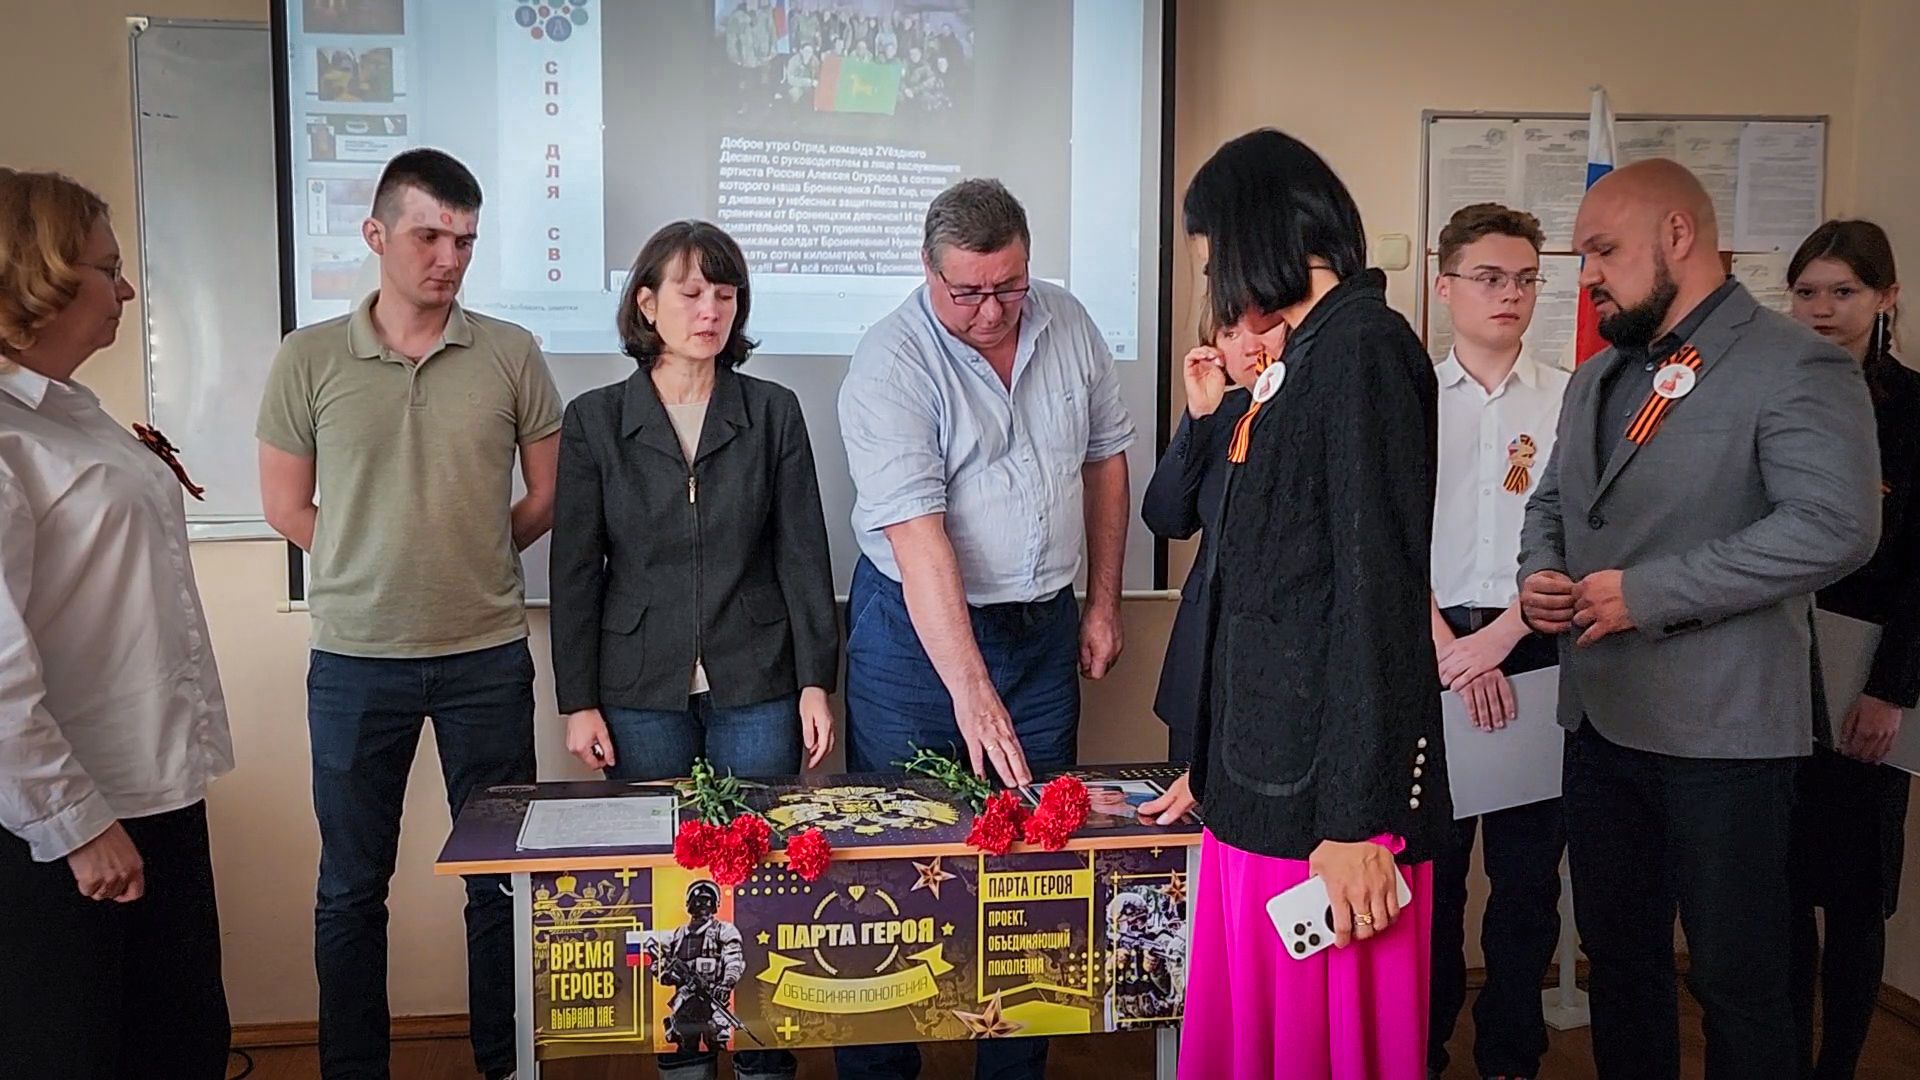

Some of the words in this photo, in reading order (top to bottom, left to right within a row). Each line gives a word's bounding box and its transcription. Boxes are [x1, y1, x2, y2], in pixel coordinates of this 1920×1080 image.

[545, 61, 559, 116] СПО
[766, 141, 790, 152] утро
[829, 145, 874, 157] команда
[720, 151, 770, 164] Десанта,
[772, 155, 779, 164] с
[781, 156, 861, 168] руководителем
[545, 144, 560, 199] ДЛЯ
[720, 167, 764, 178] артиста
[766, 167, 805, 178] России
[719, 181, 770, 193] которого
[772, 182, 800, 192] наша
[774, 210, 786, 219] от
[797, 224, 811, 234] то,
[812, 225, 830, 233] что
[781, 236, 818, 248] солдат
[548, 227, 561, 281] СВО
[857, 264, 874, 272] что
[988, 875, 1029, 898] ПАРТА
[1033, 874, 1073, 896] ГЕРОЯ
[988, 909, 1028, 927] ПРОЕКТ,
[777, 923, 857, 951] ПАРТА
[860, 917, 935, 945] ГЕРОЯ
[988, 928, 1071, 952] ОБЪЕДИНЯЮЩИЙ
[551, 940, 615, 971] ВРЕМЯ
[988, 957, 1044, 976] ПОКОЛЕНИЯ
[551, 971, 615, 1001] ГЕРОЕВ
[783, 983, 856, 1004] ОБЪЕДИНЯЯ
[860, 976, 928, 1001] ПОКОЛЕНИЯ
[551, 1007, 594, 1029] ВЫБРАЛО
